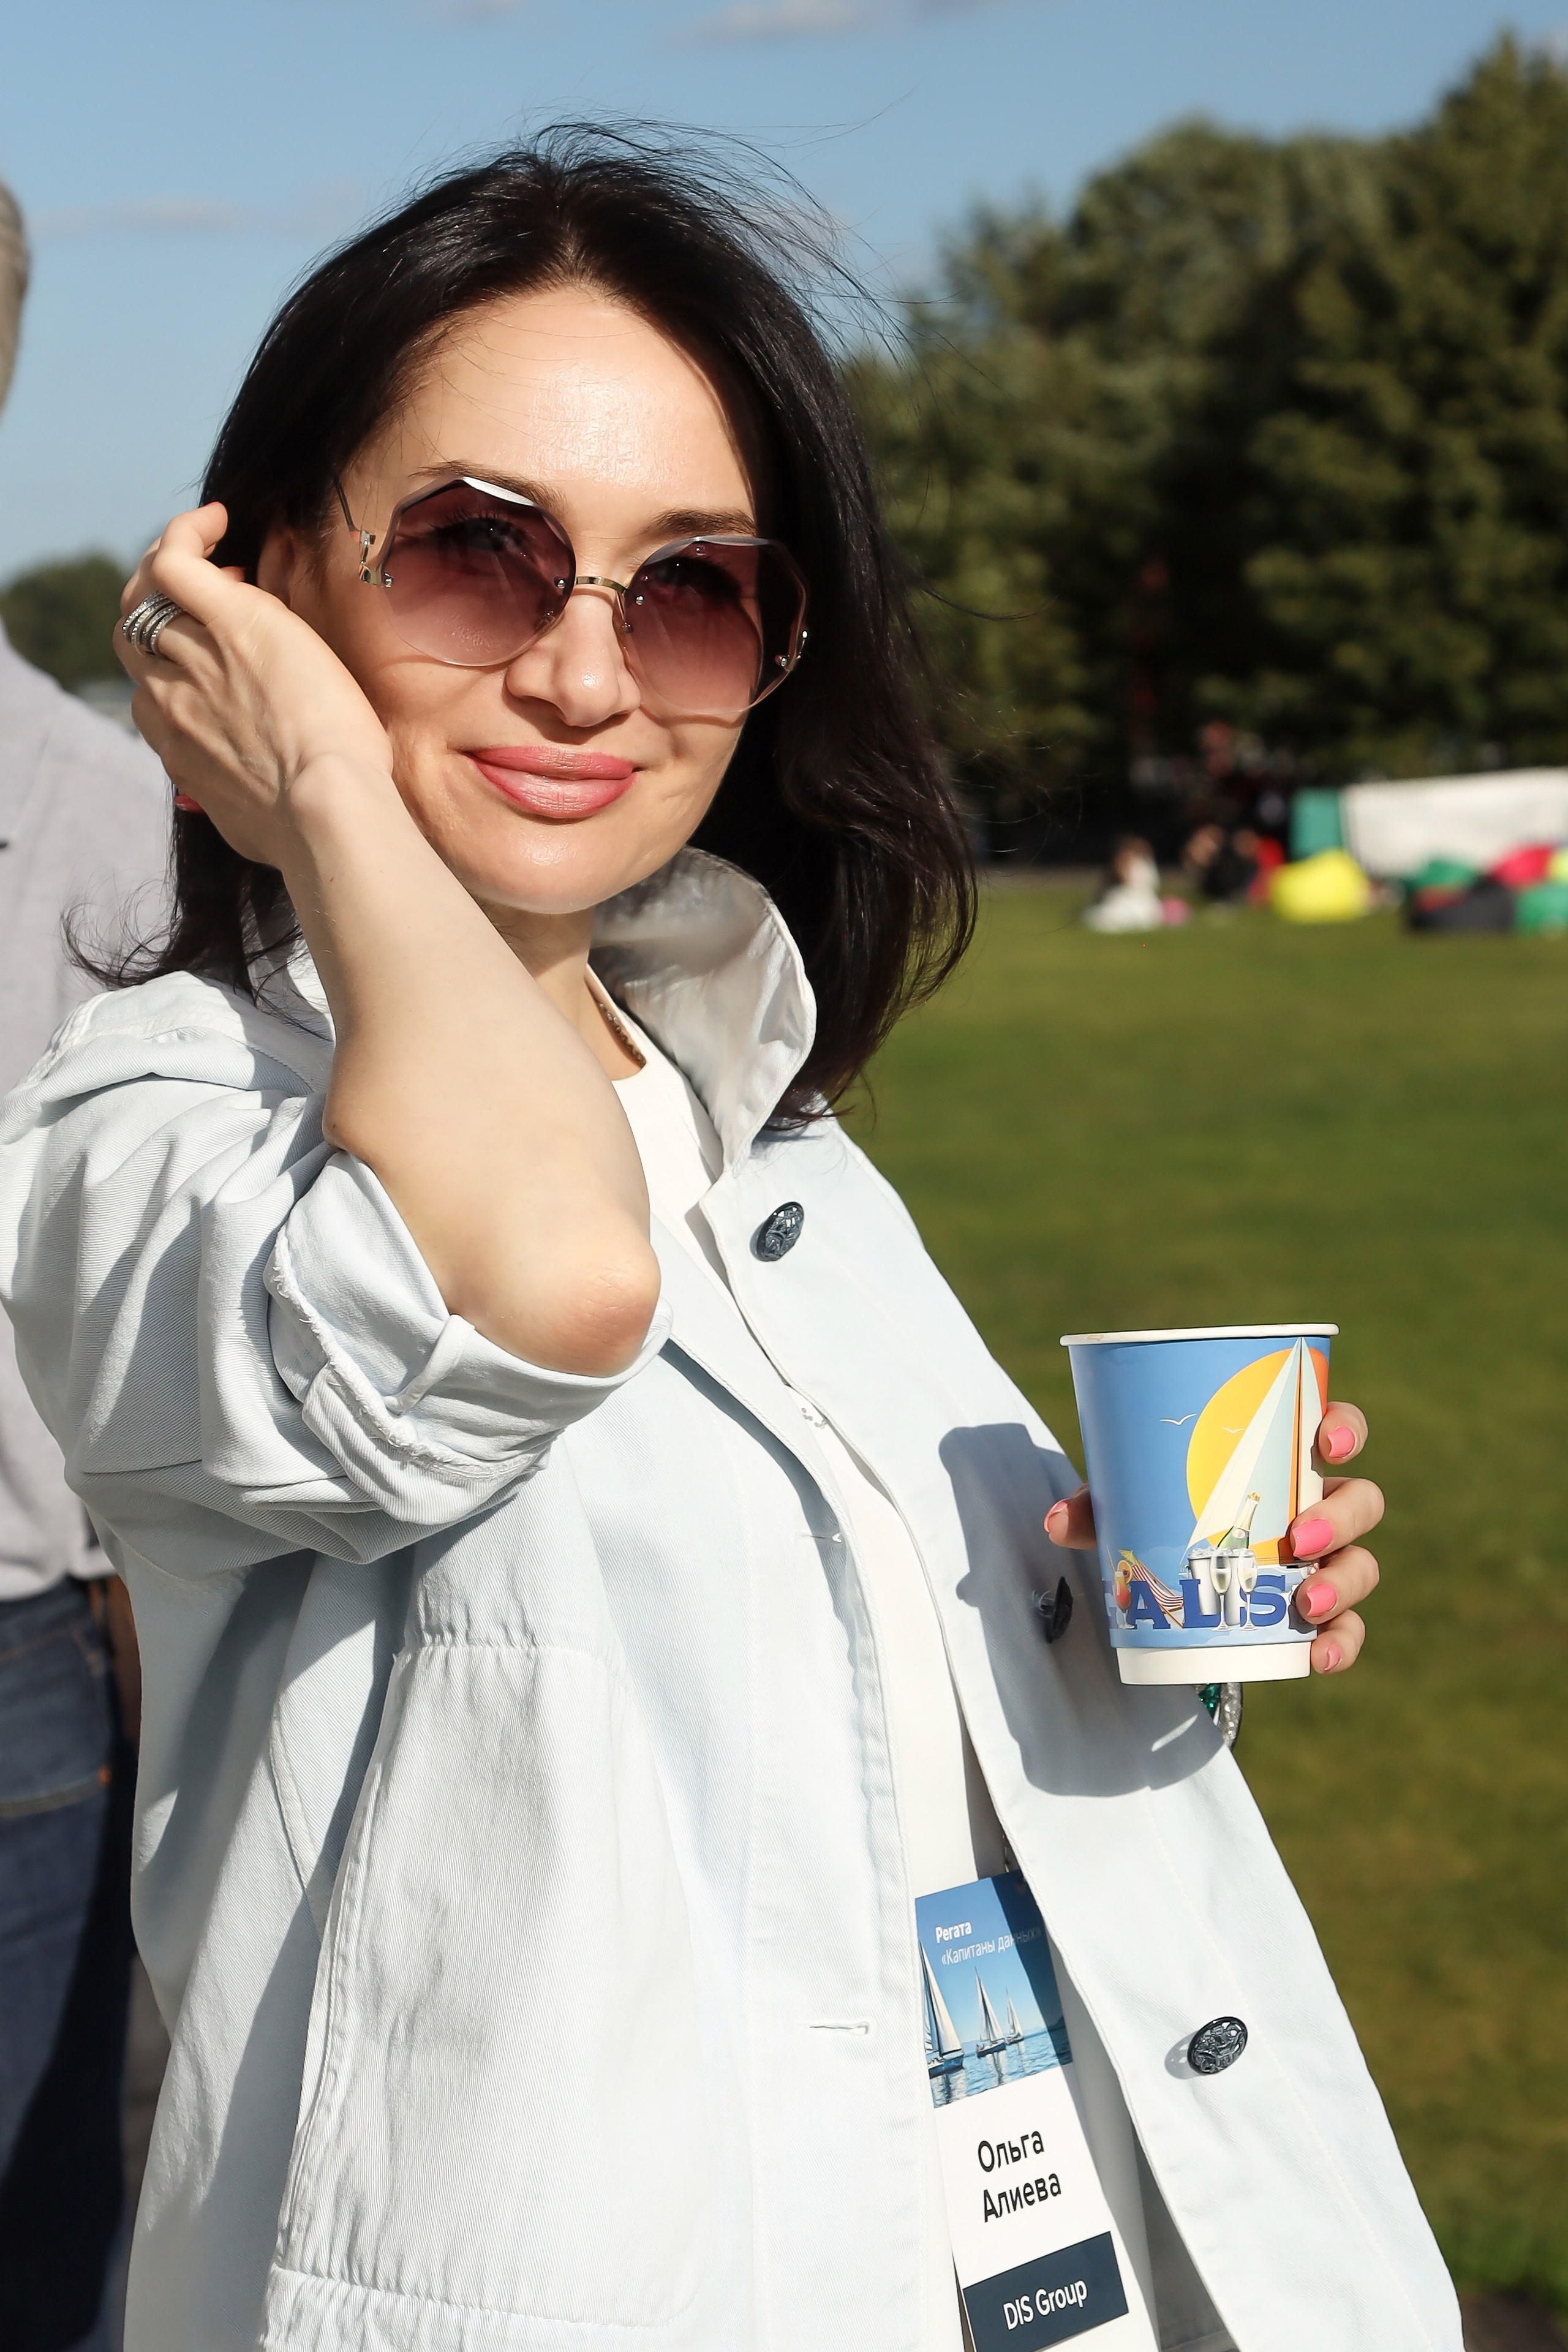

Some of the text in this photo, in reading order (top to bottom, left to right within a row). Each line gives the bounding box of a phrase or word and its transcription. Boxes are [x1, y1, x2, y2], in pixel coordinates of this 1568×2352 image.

[935, 1921, 972, 1943] Регата
[941, 1939, 995, 1966] «Капитаны
[978, 2130, 1044, 2173] Ольга
[983, 2173, 1061, 2223] Алиева
[1003, 2280, 1088, 2331] DIS Group
